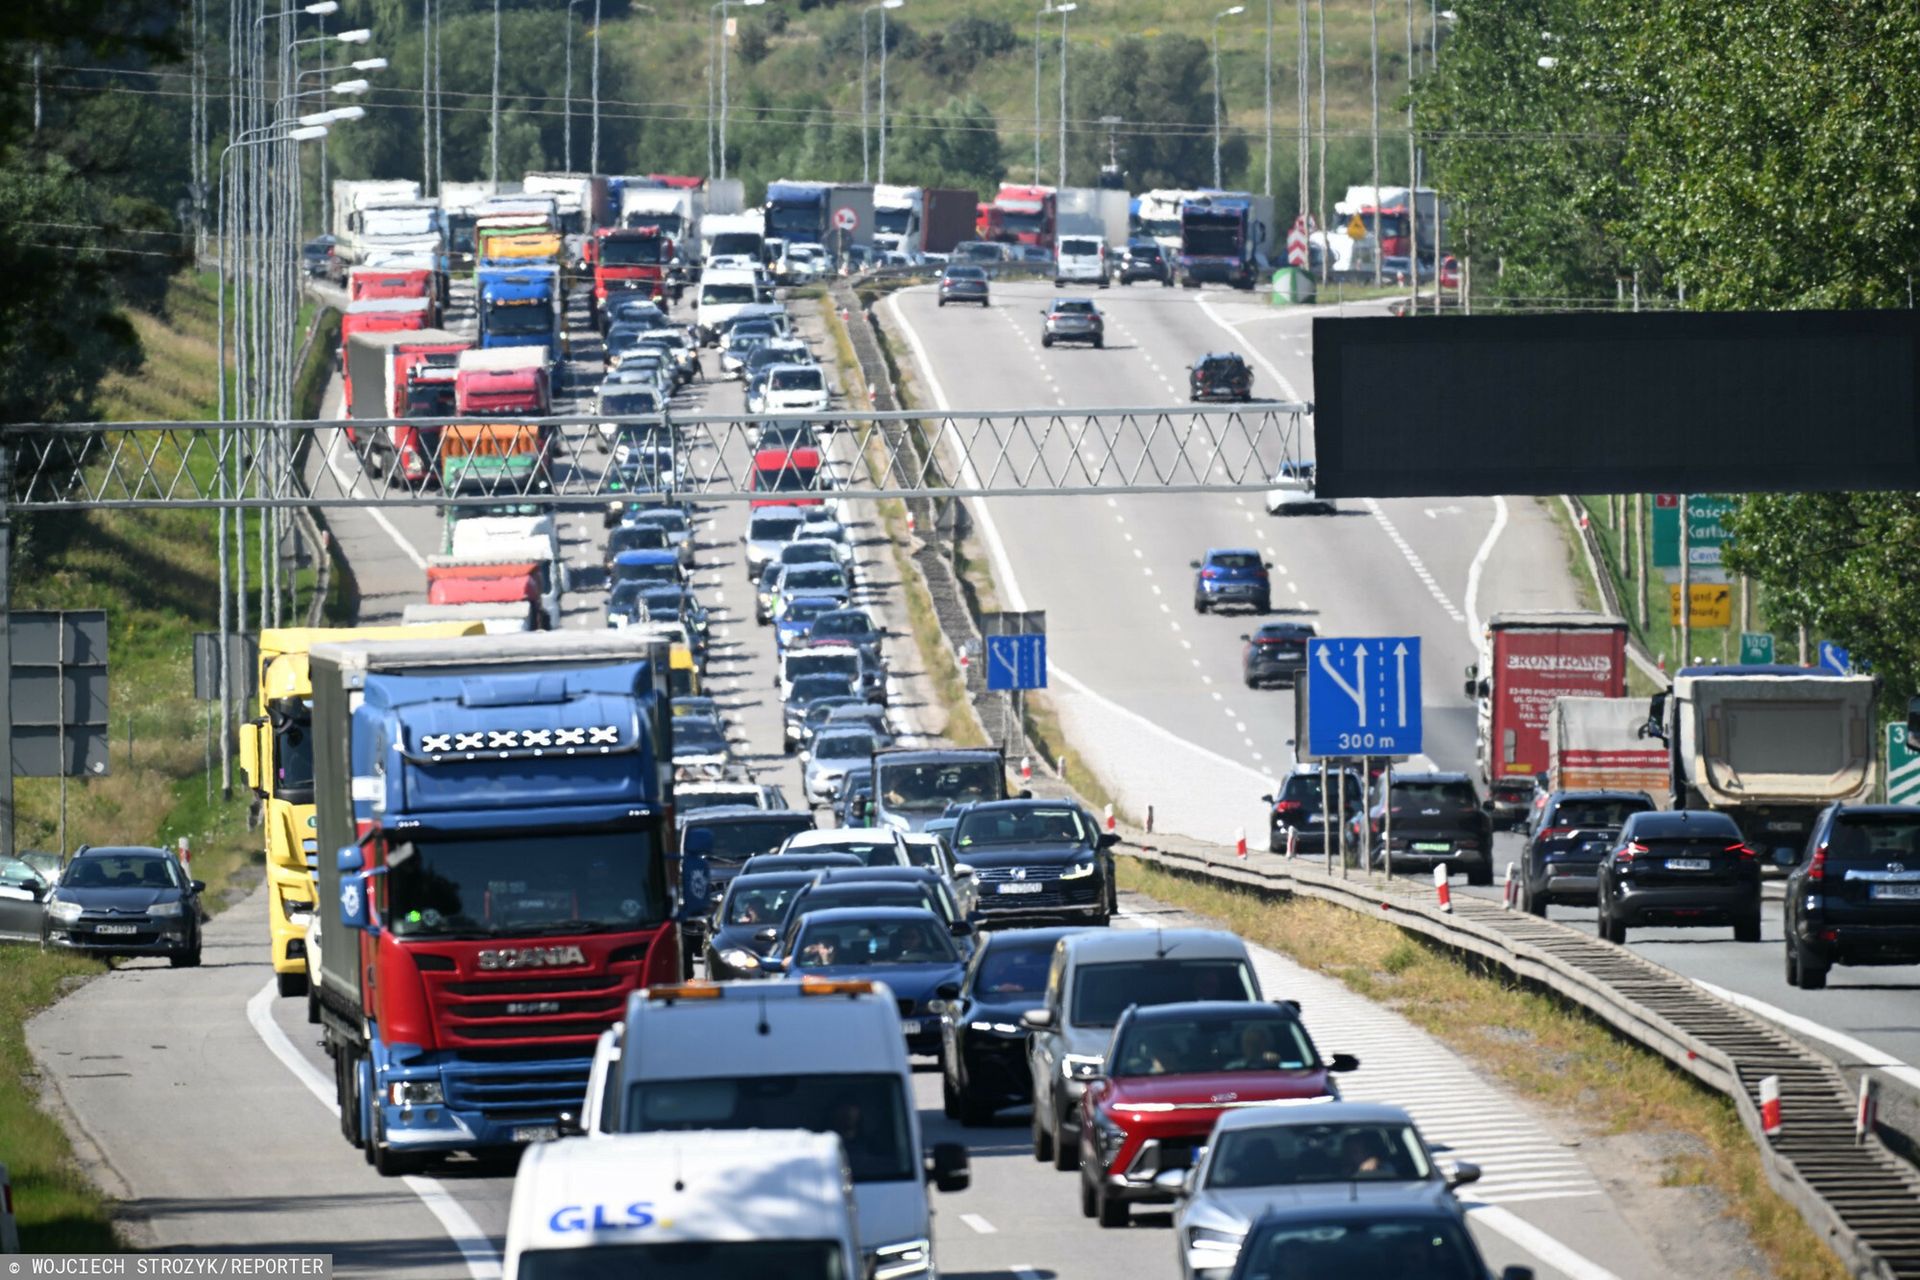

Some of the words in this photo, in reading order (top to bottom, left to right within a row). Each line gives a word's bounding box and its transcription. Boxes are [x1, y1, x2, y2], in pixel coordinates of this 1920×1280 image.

[1746, 635, 1769, 649] 100
[1338, 734, 1375, 749] 300
[1379, 737, 1395, 748] m
[478, 945, 586, 970] SCANIA
[549, 1201, 655, 1233] GLS
